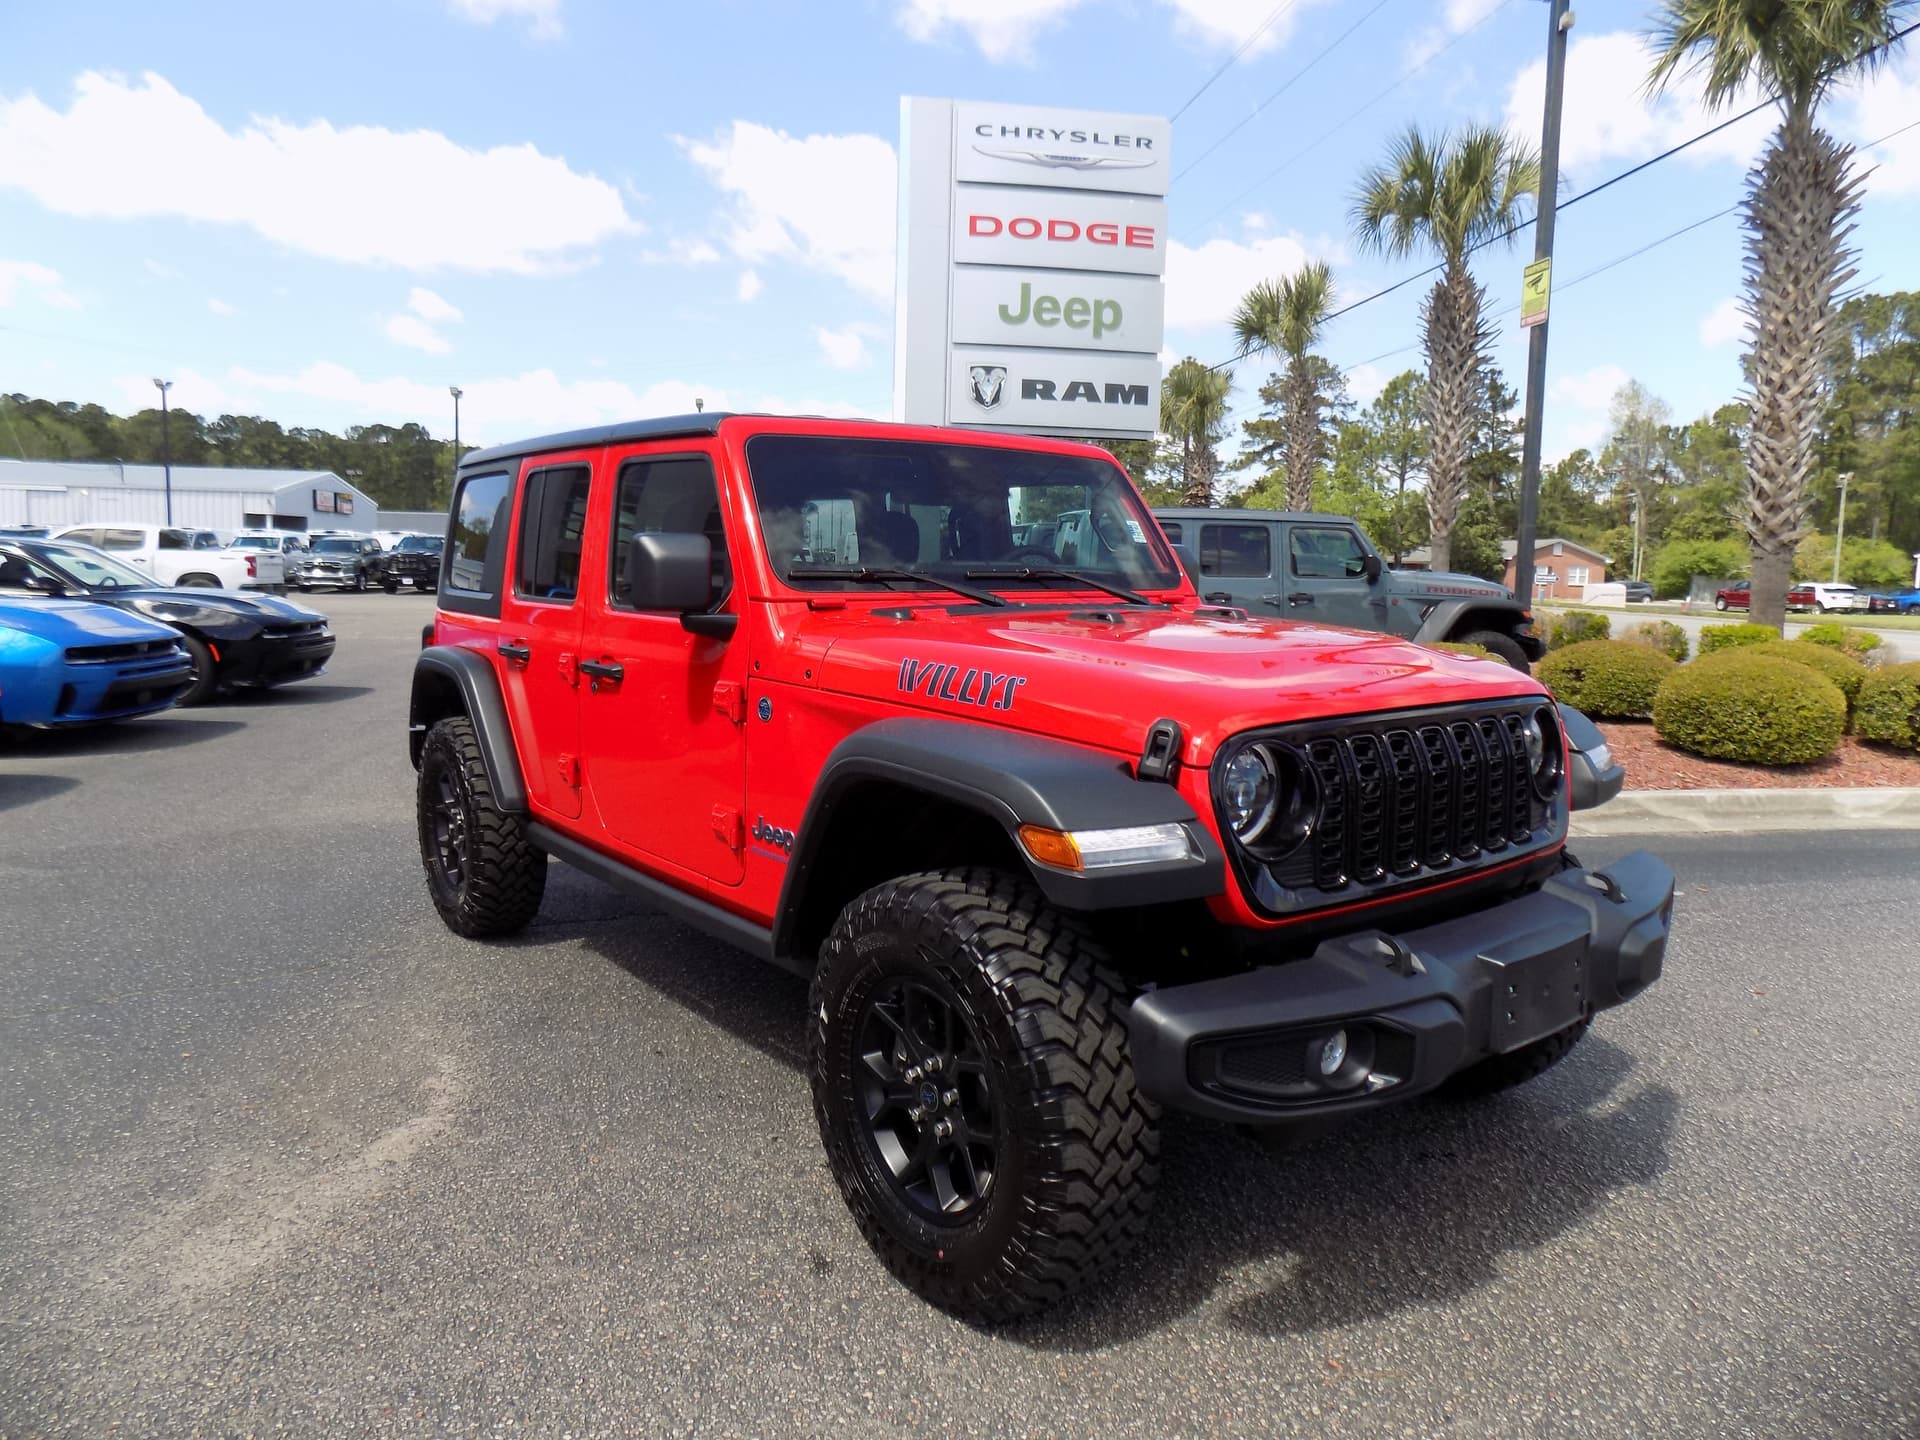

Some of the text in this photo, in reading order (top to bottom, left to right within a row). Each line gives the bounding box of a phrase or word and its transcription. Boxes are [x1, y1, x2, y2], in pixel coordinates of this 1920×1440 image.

[975, 124, 1153, 150] CHRYSLER
[968, 215, 1155, 248] DODGE
[998, 282, 1123, 338] Jeep
[1021, 378, 1149, 406] RAM
[1426, 584, 1502, 597] RUBICON
[898, 657, 1027, 711] WILLYS
[752, 815, 796, 855] Jeep
